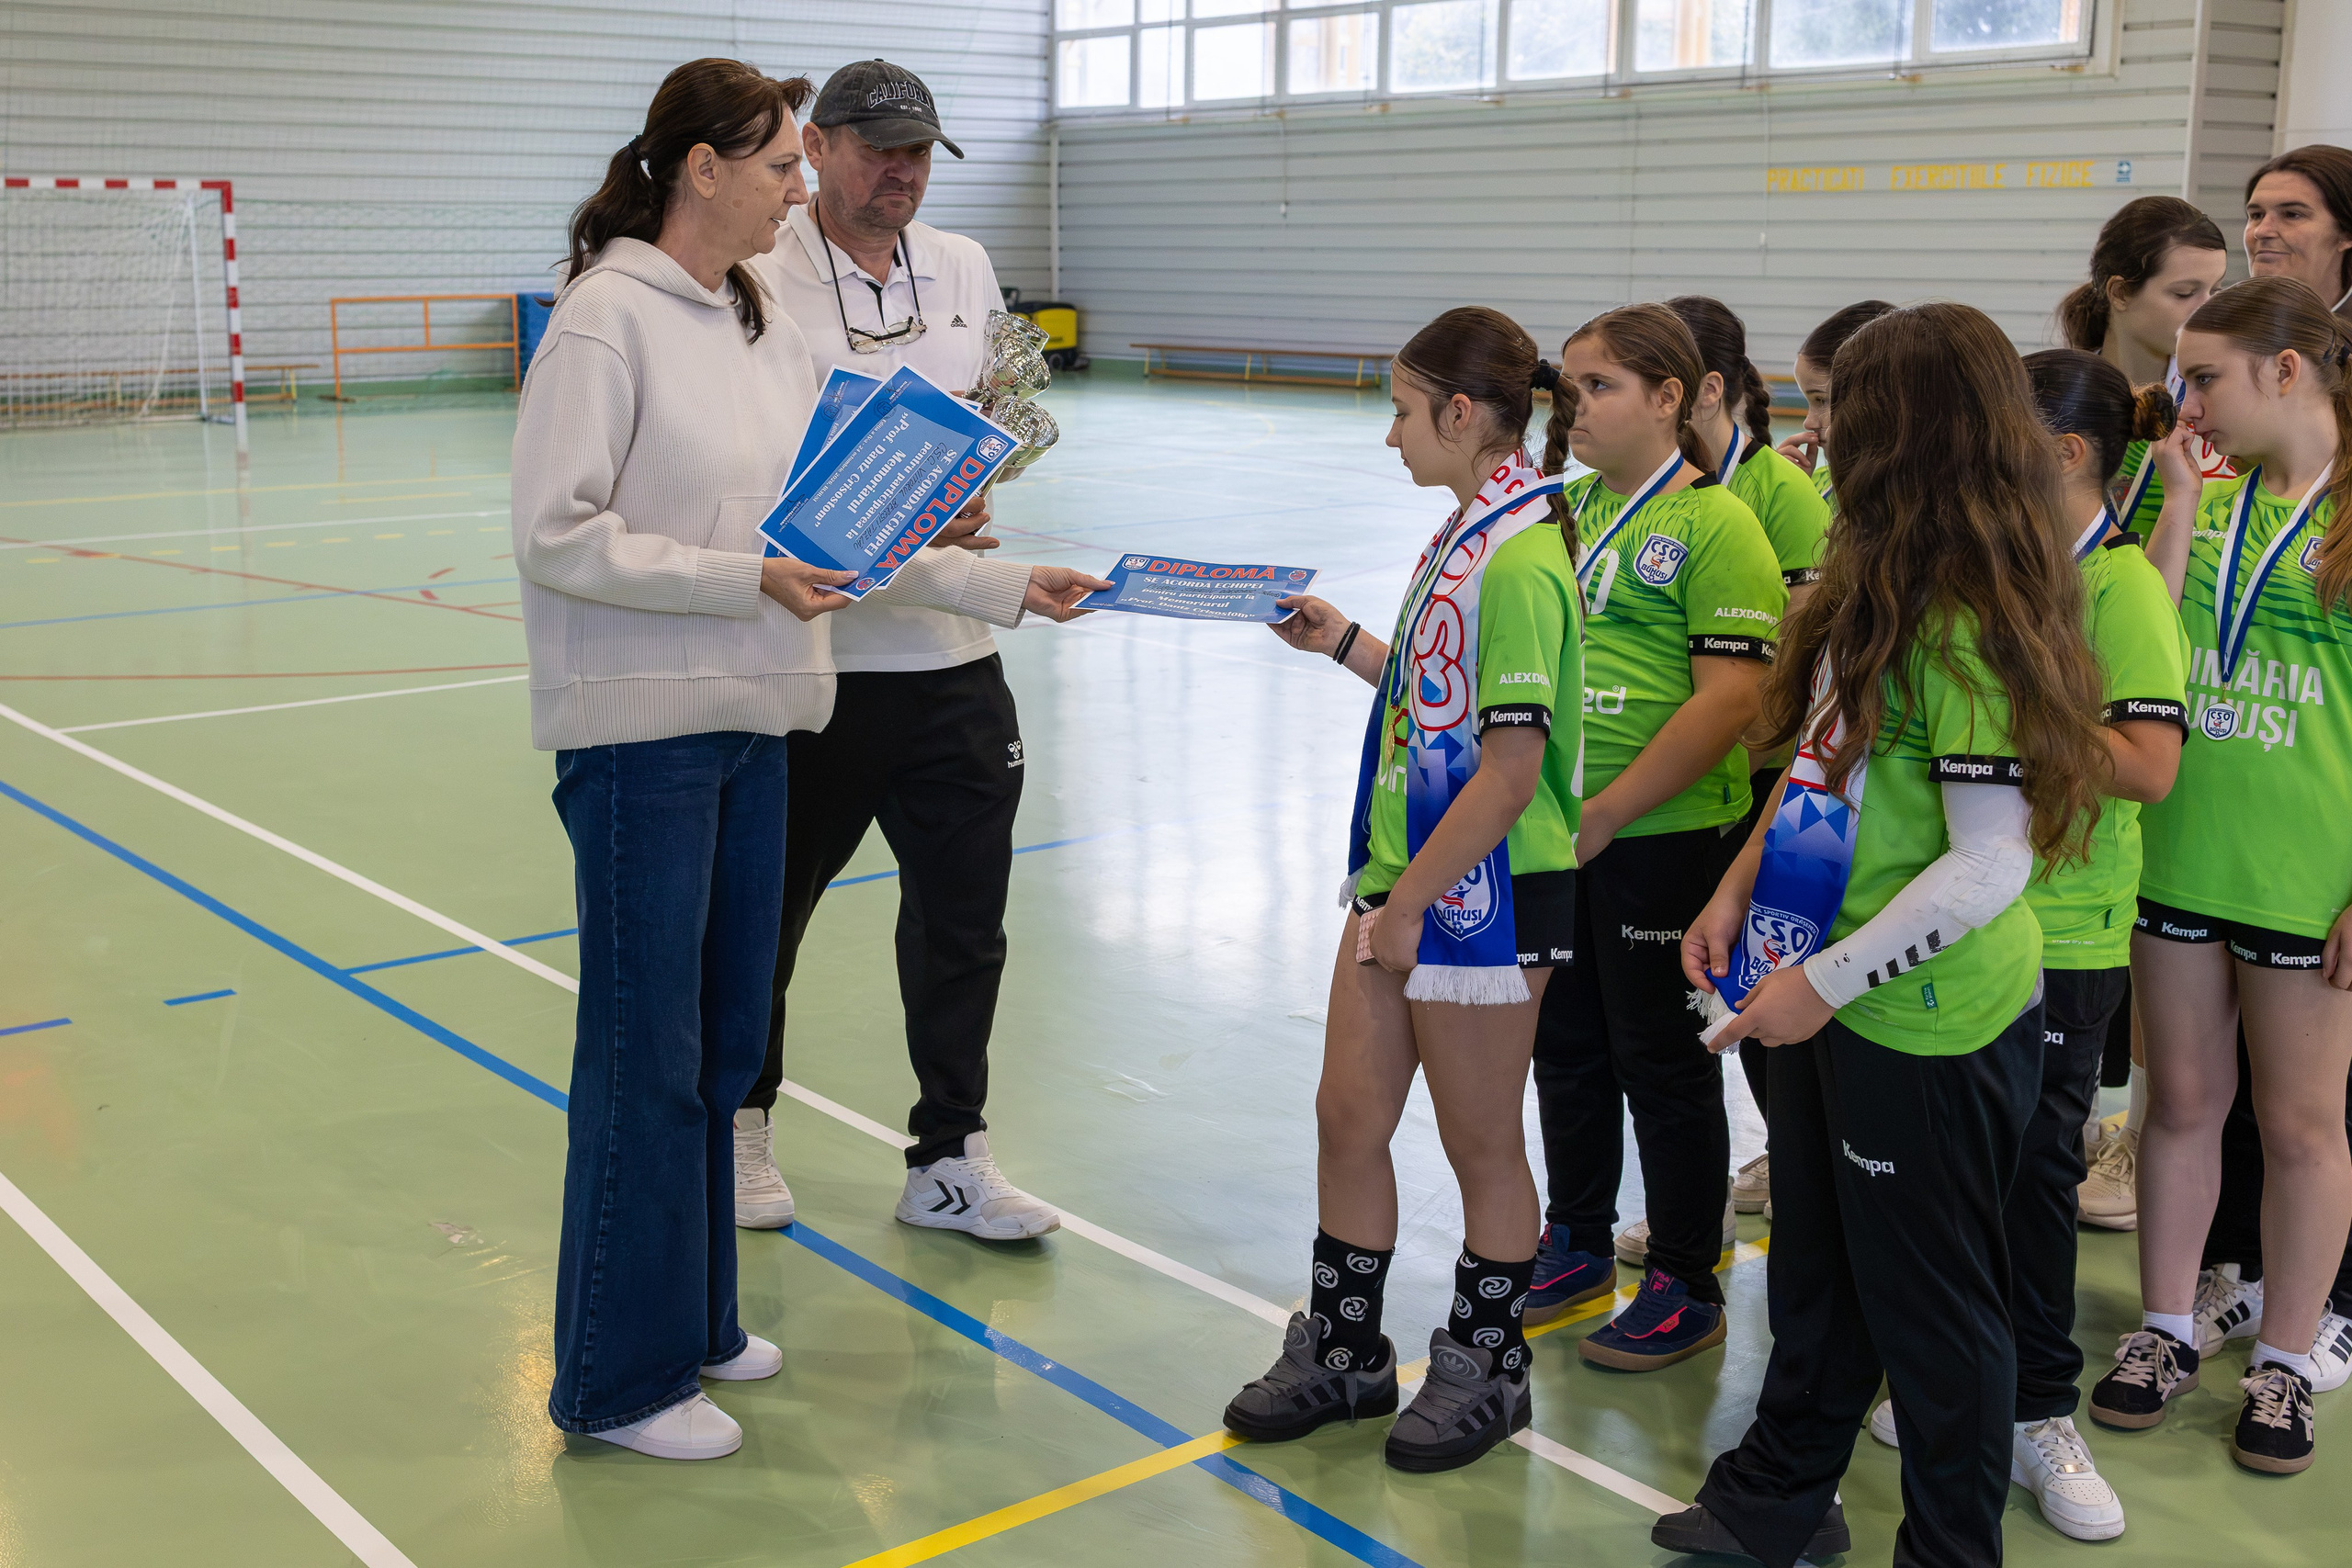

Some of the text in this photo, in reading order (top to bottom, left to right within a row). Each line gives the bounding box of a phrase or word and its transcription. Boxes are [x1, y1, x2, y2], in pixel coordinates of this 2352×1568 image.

[2026, 161, 2095, 188] FIZICE
[856, 444, 886, 473] Dantz
[844, 441, 934, 540] pentru participarea la
[846, 449, 905, 513] Memoriarul
[863, 448, 958, 556] SE ACORDĂ ECHIPEI
[875, 456, 986, 570] DIPLOMĂ
[1651, 540, 1680, 561] CSO
[1148, 559, 1277, 579] DIPLOMĂ
[1162, 579, 1212, 588] ACORDĂ
[1158, 602, 1190, 610] Dantz
[1704, 637, 1748, 652] Kempa
[1490, 710, 1532, 725] Kempa
[2128, 701, 2178, 716] Kempa
[2211, 711, 2231, 721] CSO
[1939, 758, 1993, 778] Kempa
[1764, 909, 1789, 919] SPORTIV
[1622, 924, 1682, 945] Kempa
[1751, 914, 1808, 953] CSO
[2162, 922, 2207, 940] Kempa
[1551, 948, 1573, 962] Kempa
[2230, 939, 2256, 961] Kempa
[2271, 952, 2321, 967] Kempa
[1842, 1139, 1894, 1177] Kempa
